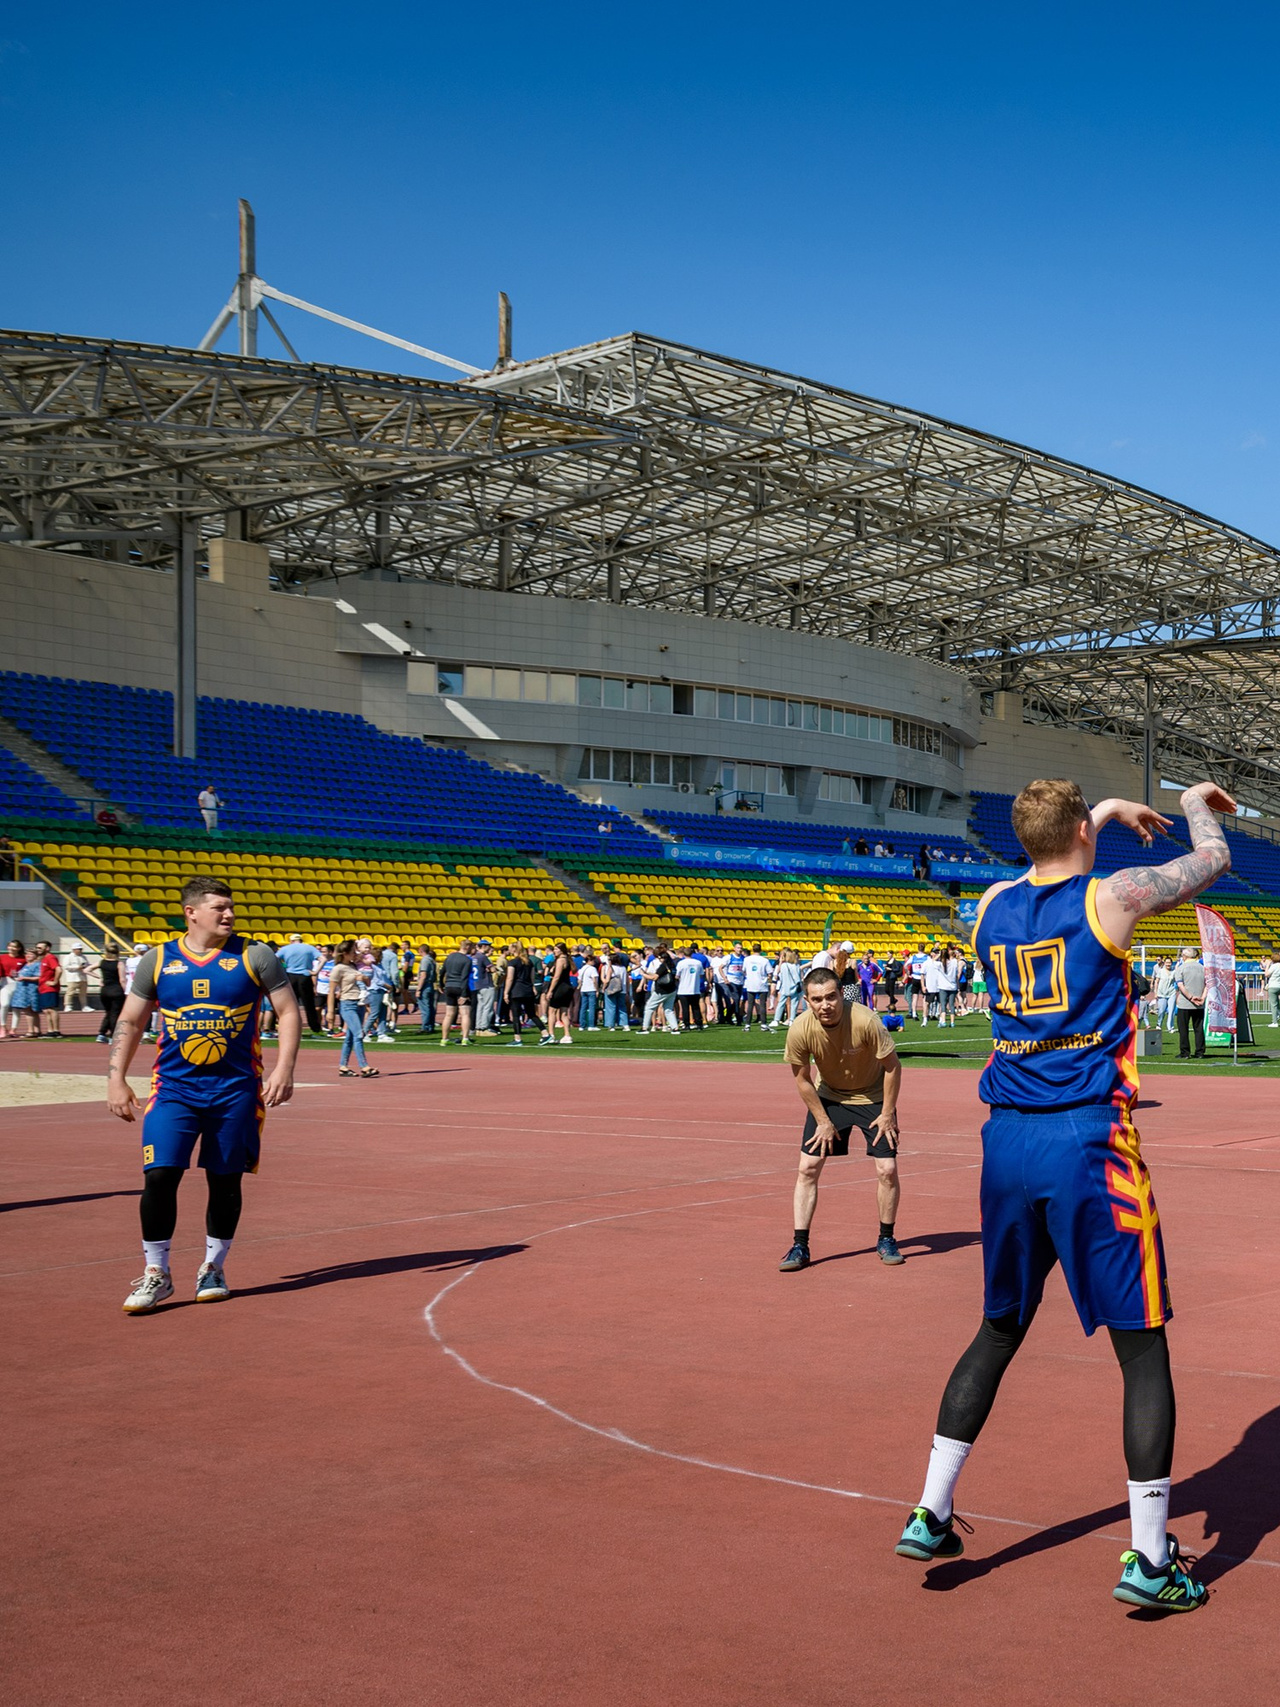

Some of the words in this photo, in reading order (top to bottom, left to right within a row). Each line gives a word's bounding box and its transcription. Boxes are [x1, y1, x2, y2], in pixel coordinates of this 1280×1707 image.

[989, 937, 1069, 1017] 10
[192, 979, 210, 998] 8
[175, 1019, 234, 1031] ЛЕГЕНДА
[992, 1030, 1104, 1055] НТЫ-МАНСИЙСК
[143, 1144, 155, 1166] 8
